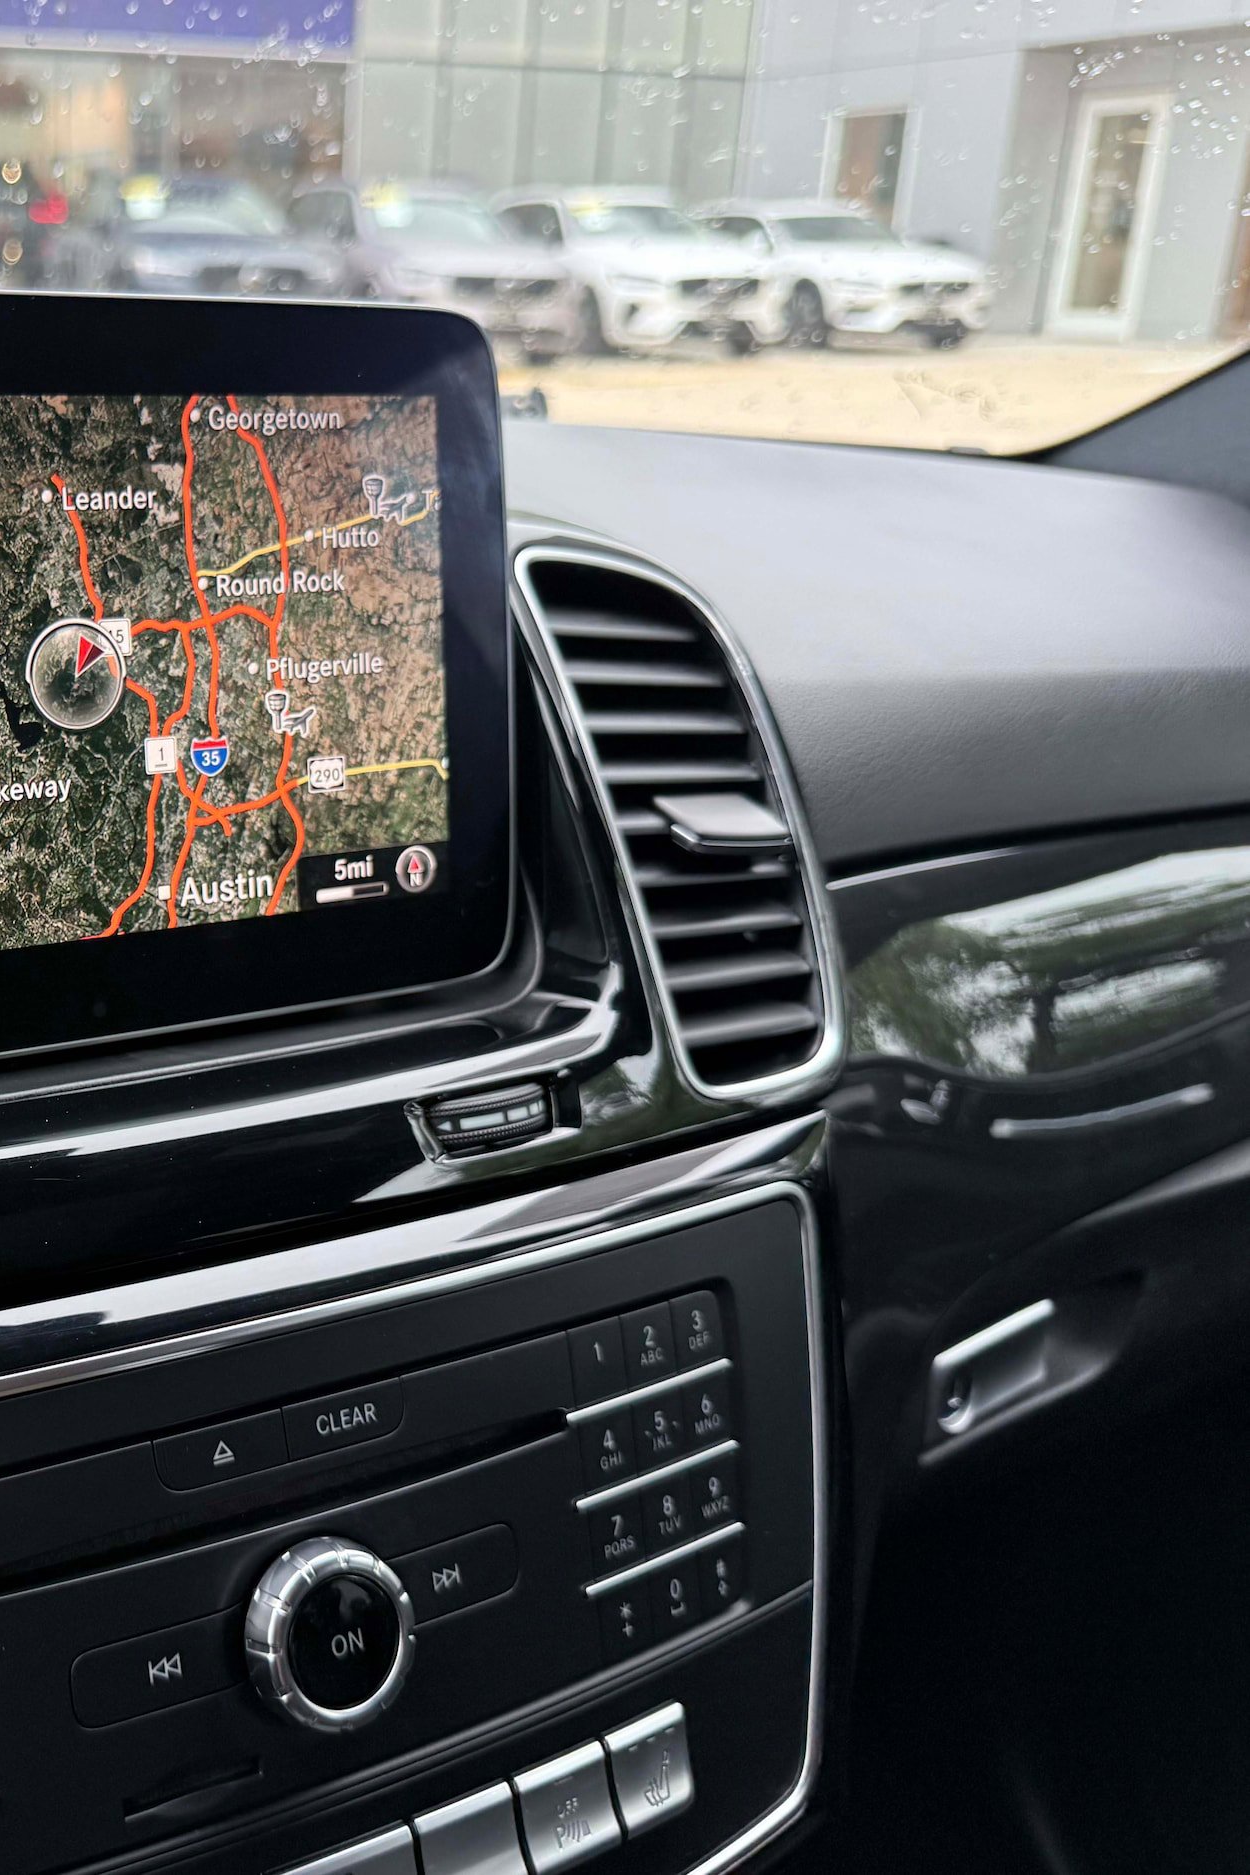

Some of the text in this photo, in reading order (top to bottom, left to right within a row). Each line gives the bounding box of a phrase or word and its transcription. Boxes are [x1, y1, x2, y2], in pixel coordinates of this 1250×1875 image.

[208, 407, 341, 437] Georgetown
[62, 486, 157, 511] Leander
[322, 527, 380, 549] Hutto
[216, 569, 346, 597] Round Rock
[265, 653, 385, 685] Pflugerville
[201, 750, 221, 767] 35
[314, 767, 340, 784] 290
[334, 854, 375, 881] 5mi
[181, 871, 274, 907] Austin
[409, 871, 424, 887] N
[691, 1309, 704, 1331] 3
[643, 1325, 655, 1347] 2
[688, 1331, 710, 1350] DEF
[593, 1341, 604, 1362] 1
[640, 1348, 664, 1367] ABC
[700, 1394, 713, 1416] 6
[315, 1402, 378, 1436] CLEAR
[654, 1410, 666, 1433] 5
[603, 1429, 616, 1451] 4
[599, 1450, 623, 1472] GHI
[708, 1477, 720, 1498] 9
[663, 1495, 675, 1517] 8
[611, 1514, 624, 1537] 7
[670, 1578, 681, 1600] 0
[330, 1628, 365, 1660] ON
